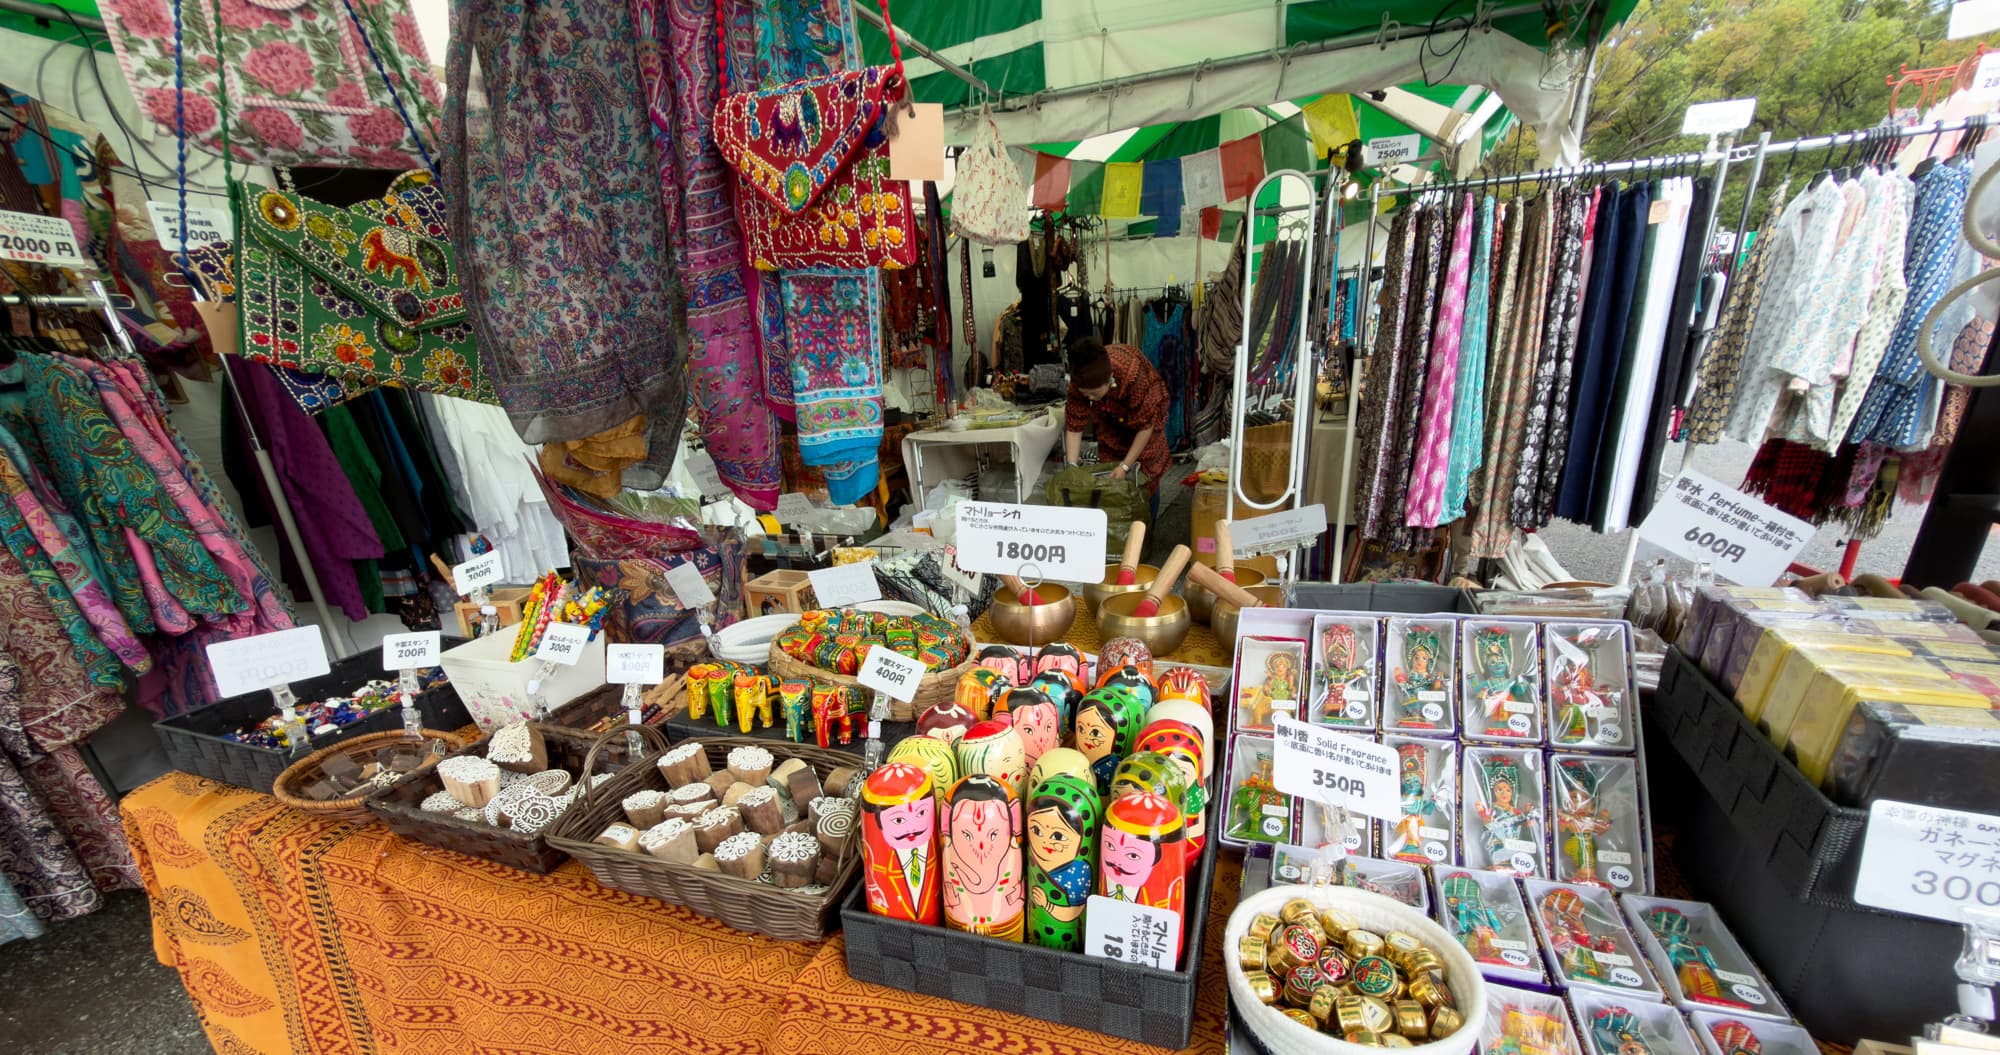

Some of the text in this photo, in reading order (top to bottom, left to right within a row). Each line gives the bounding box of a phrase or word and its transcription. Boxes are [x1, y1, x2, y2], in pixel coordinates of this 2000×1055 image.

[1377, 147, 1409, 159] 2500円
[168, 227, 222, 242] 200円
[1675, 476, 1705, 496] 香水
[963, 506, 1022, 520] マトリョーシカ
[1683, 526, 1747, 564] 600円
[996, 541, 1066, 564] 1800円
[397, 647, 426, 659] 200円
[549, 643, 572, 654] 300円
[875, 666, 906, 686] 400円
[1510, 718, 1527, 728] 800
[1601, 727, 1618, 739] 800
[1317, 737, 1338, 751] Solid
[1340, 743, 1388, 765] Fragrance
[1313, 769, 1366, 798] 350円
[1427, 847, 1444, 857] 800
[1514, 857, 1531, 868] 800
[1611, 871, 1629, 882] 800
[1615, 972, 1638, 983] 800
[1736, 988, 1760, 1001] 800
